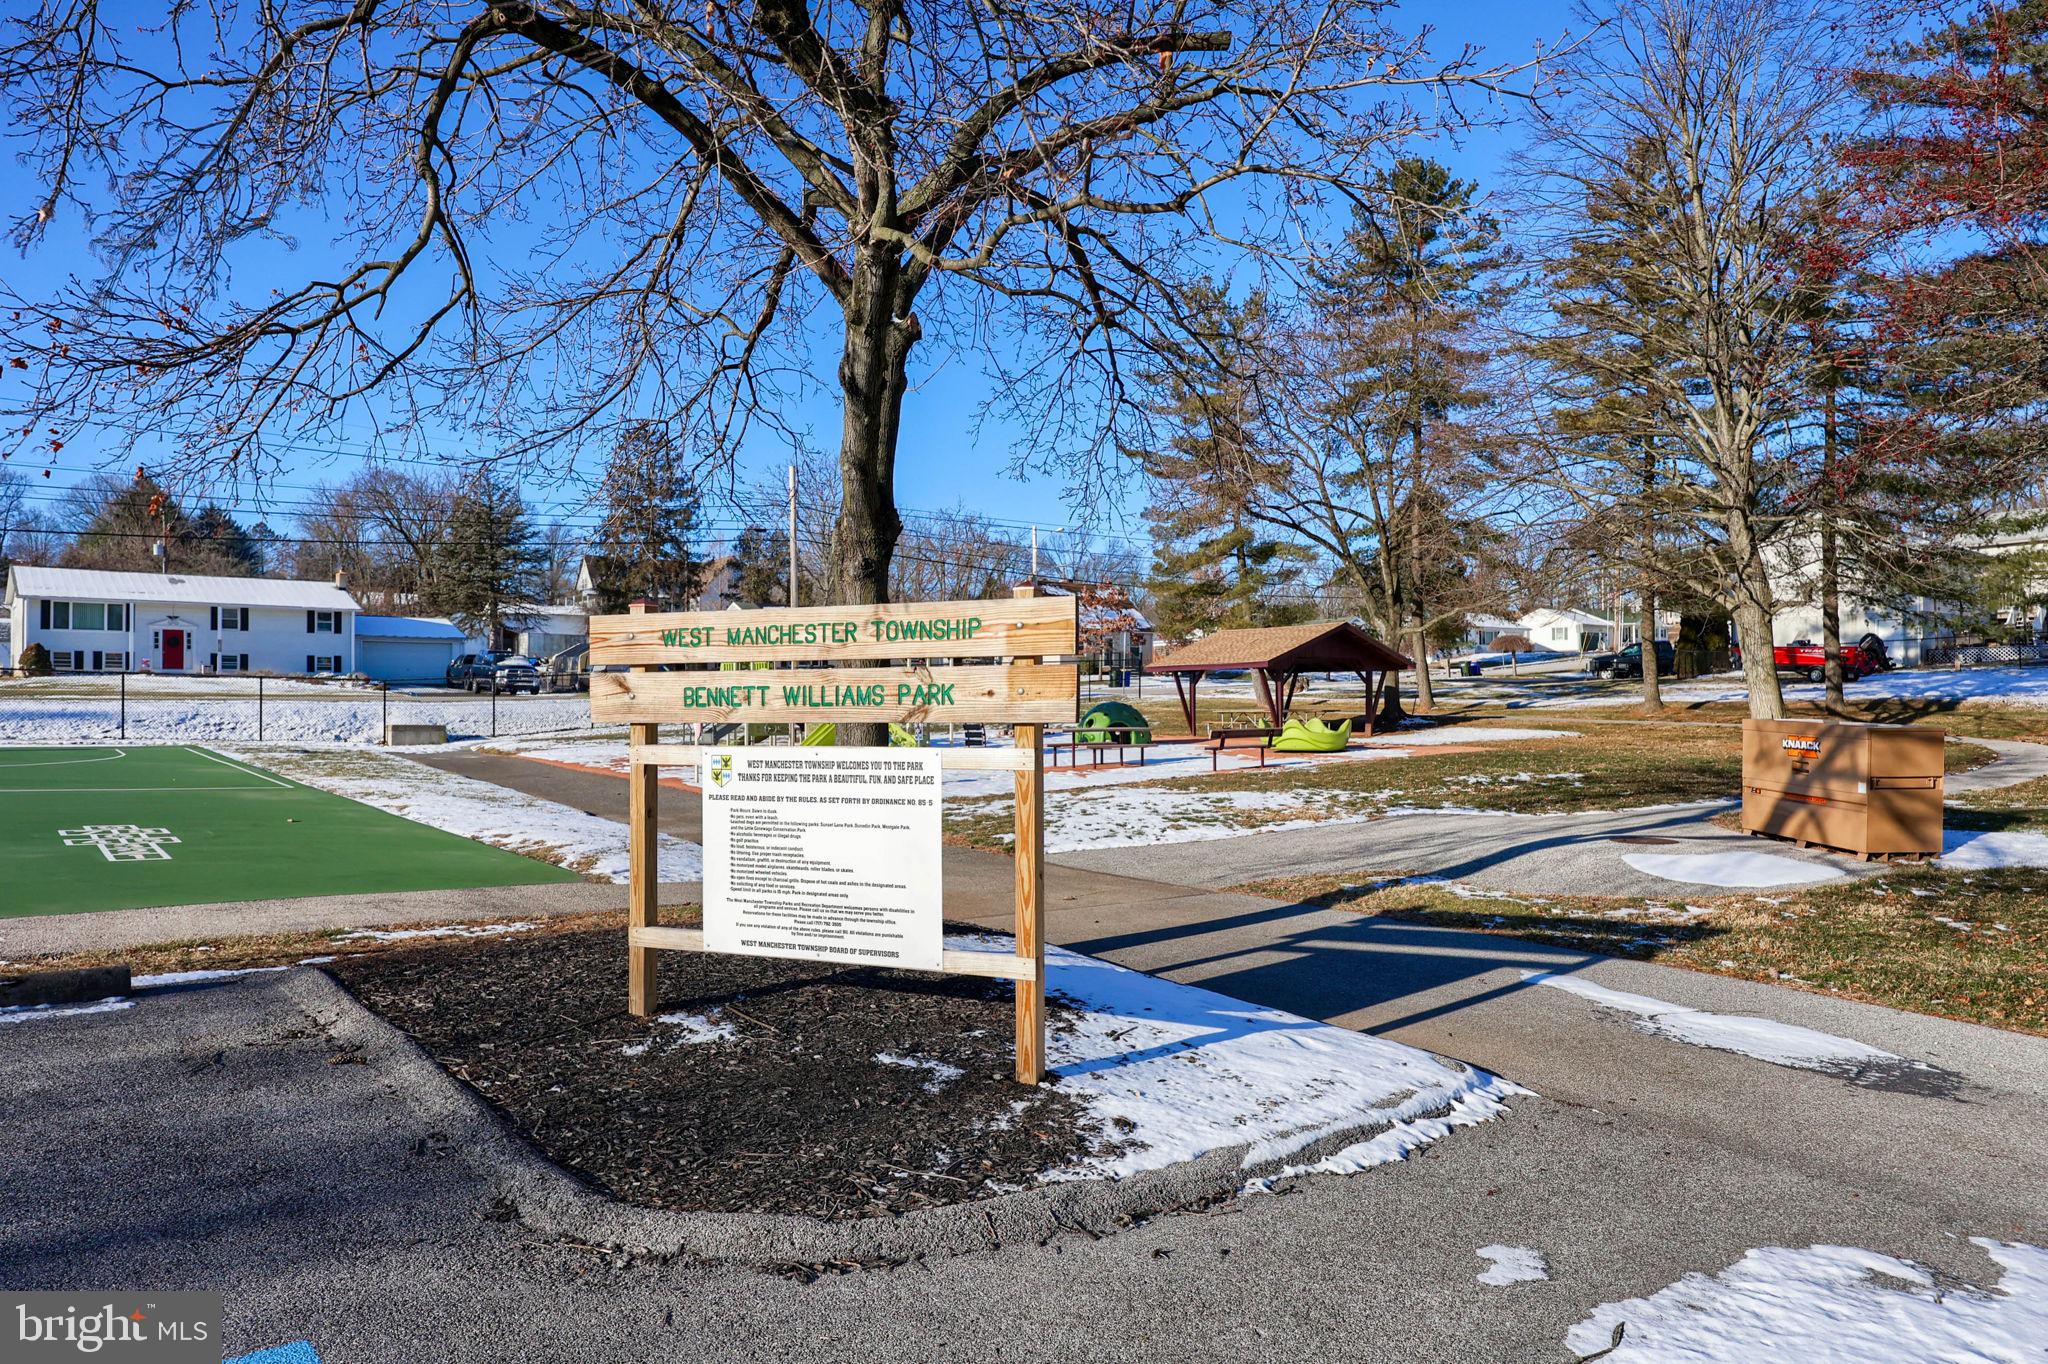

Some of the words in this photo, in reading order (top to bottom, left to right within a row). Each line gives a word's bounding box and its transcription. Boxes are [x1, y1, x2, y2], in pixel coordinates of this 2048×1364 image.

[661, 627, 714, 648] WEST
[727, 622, 857, 645] MANCHESTER
[871, 617, 982, 641] TOWNSHIP
[683, 685, 770, 707] BENNETT
[782, 684, 885, 707] WILLIAMS
[898, 683, 955, 705] PARK
[1782, 739, 1820, 751] KNAACK
[747, 760, 763, 768] WEST
[765, 760, 803, 769] MANCHESTER
[805, 761, 835, 770] TOWNSHIP
[836, 761, 869, 770] WELCOMES
[871, 762, 882, 770] YOU
[884, 762, 892, 770] TO
[893, 762, 905, 770] THE
[907, 762, 923, 771] PARK
[738, 773, 760, 781] THANKS
[762, 773, 772, 782] FOR
[774, 773, 798, 782] KEEPING
[799, 774, 810, 782] THE
[812, 774, 827, 783] PARK
[829, 774, 832, 783] A
[884, 775, 896, 784] AND
[898, 776, 913, 784] SAFE
[915, 776, 934, 785] PLACE
[741, 939, 756, 947] WEST
[758, 941, 796, 950] MANCHESTER
[798, 944, 828, 953] TOWNSHIP
[829, 946, 848, 955] BOARD
[858, 948, 899, 959] SUPERVISORS
